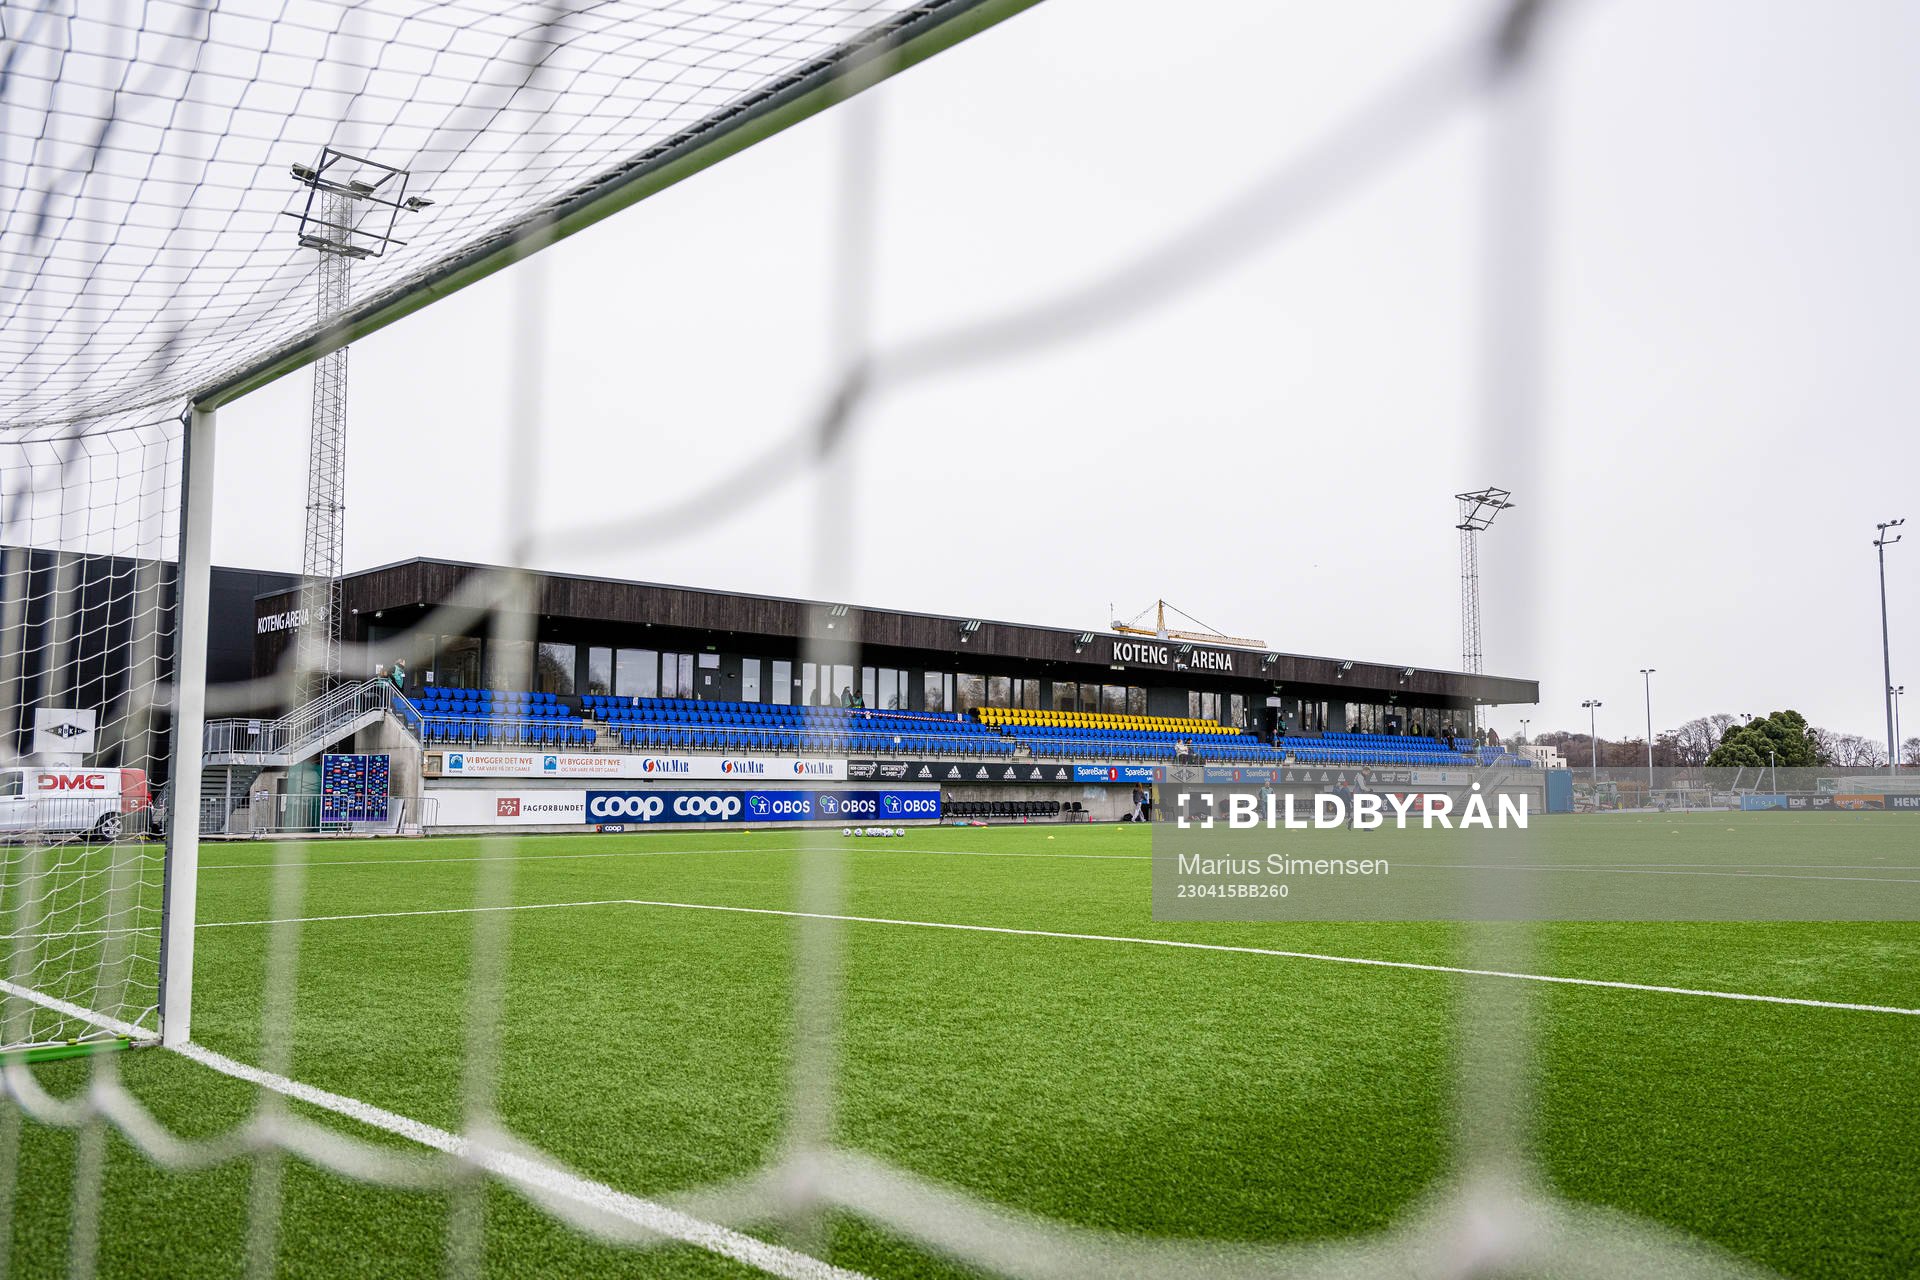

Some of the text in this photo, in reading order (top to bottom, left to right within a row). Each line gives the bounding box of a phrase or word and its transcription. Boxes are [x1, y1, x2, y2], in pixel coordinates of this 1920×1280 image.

[257, 608, 310, 634] KOTENG ARENA
[1113, 641, 1233, 671] KOTENG ARENA
[1077, 766, 1108, 776] SpareBank
[1124, 767, 1153, 777] SpareBank
[1207, 769, 1232, 778] SpareBank
[1246, 769, 1270, 778] SpareBank
[38, 774, 105, 790] DMC
[523, 804, 584, 812] FAGFORBUNDET
[590, 796, 664, 821] coop
[673, 796, 741, 820] coop
[772, 800, 811, 813] OBOS
[841, 800, 876, 813] OBOS
[903, 799, 936, 812] OBOS
